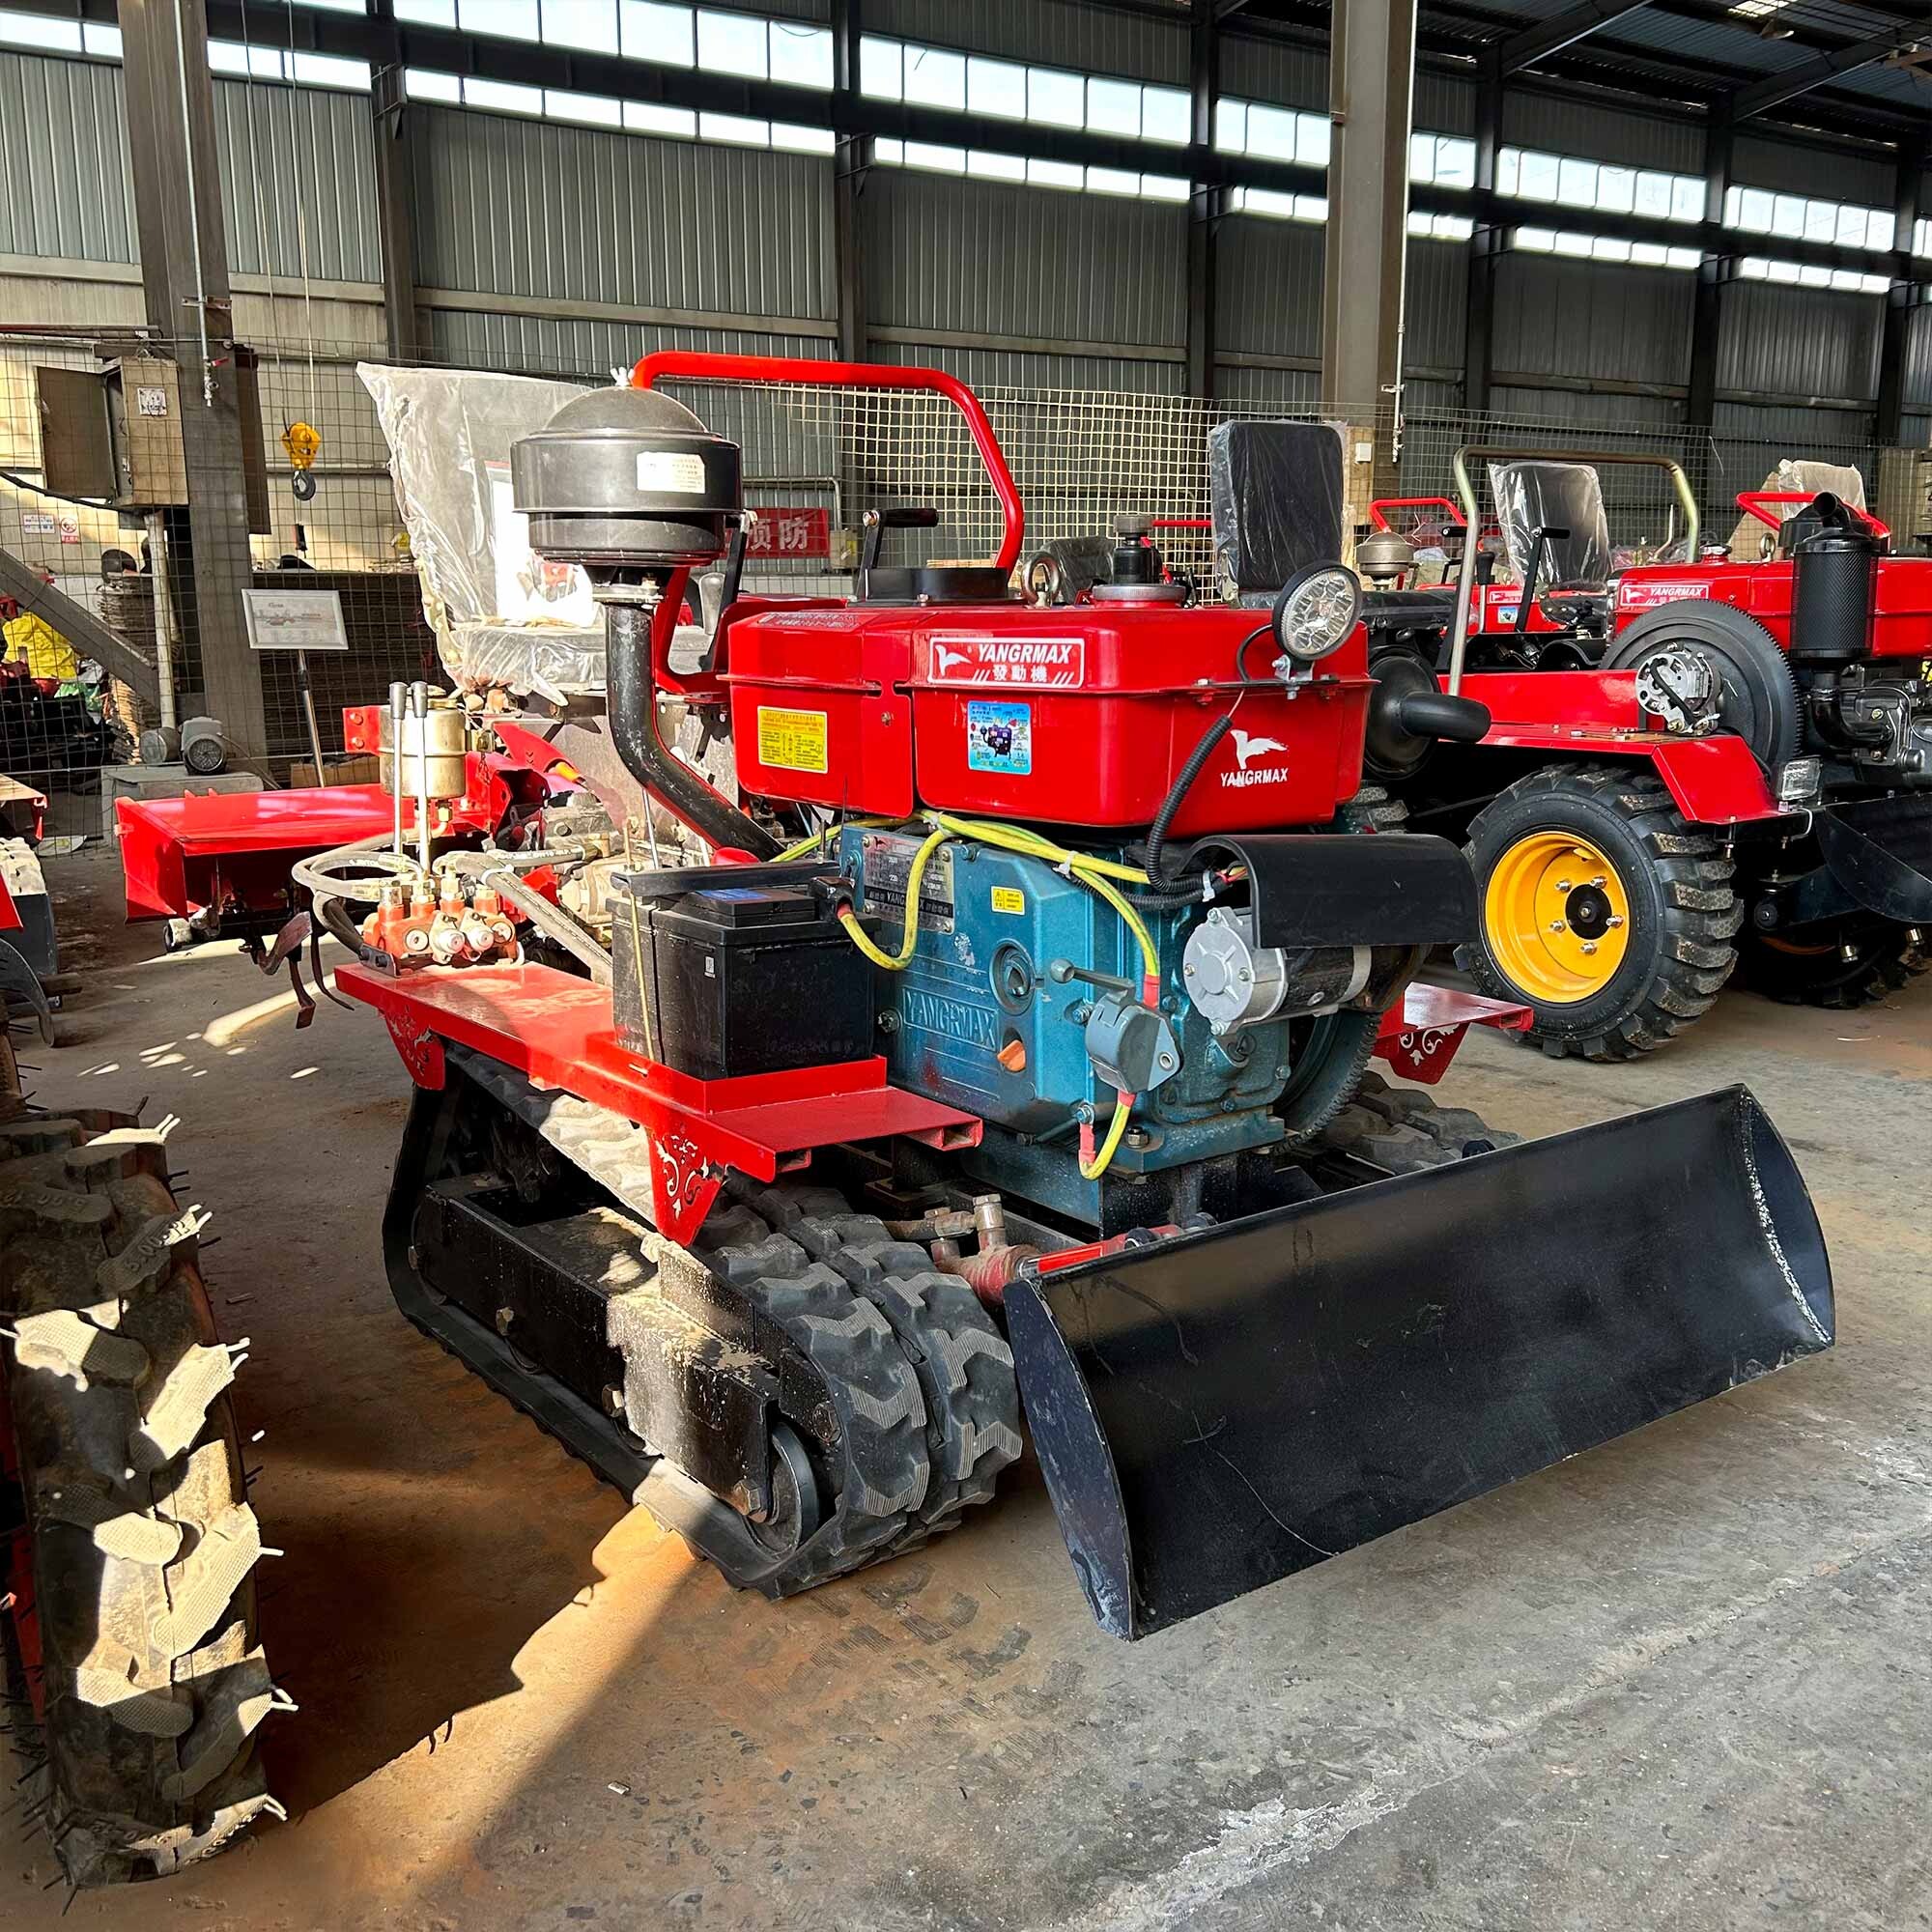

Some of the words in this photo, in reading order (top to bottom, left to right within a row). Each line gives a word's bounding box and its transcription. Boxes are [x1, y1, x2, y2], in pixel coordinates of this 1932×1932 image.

[1650, 586, 1703, 597] YANGRMAX
[978, 643, 1072, 665] YANGRMAX
[992, 664, 1047, 683] 發動機
[1220, 768, 1289, 787] YANGRMAX
[906, 990, 996, 1049] YANGRMAX
